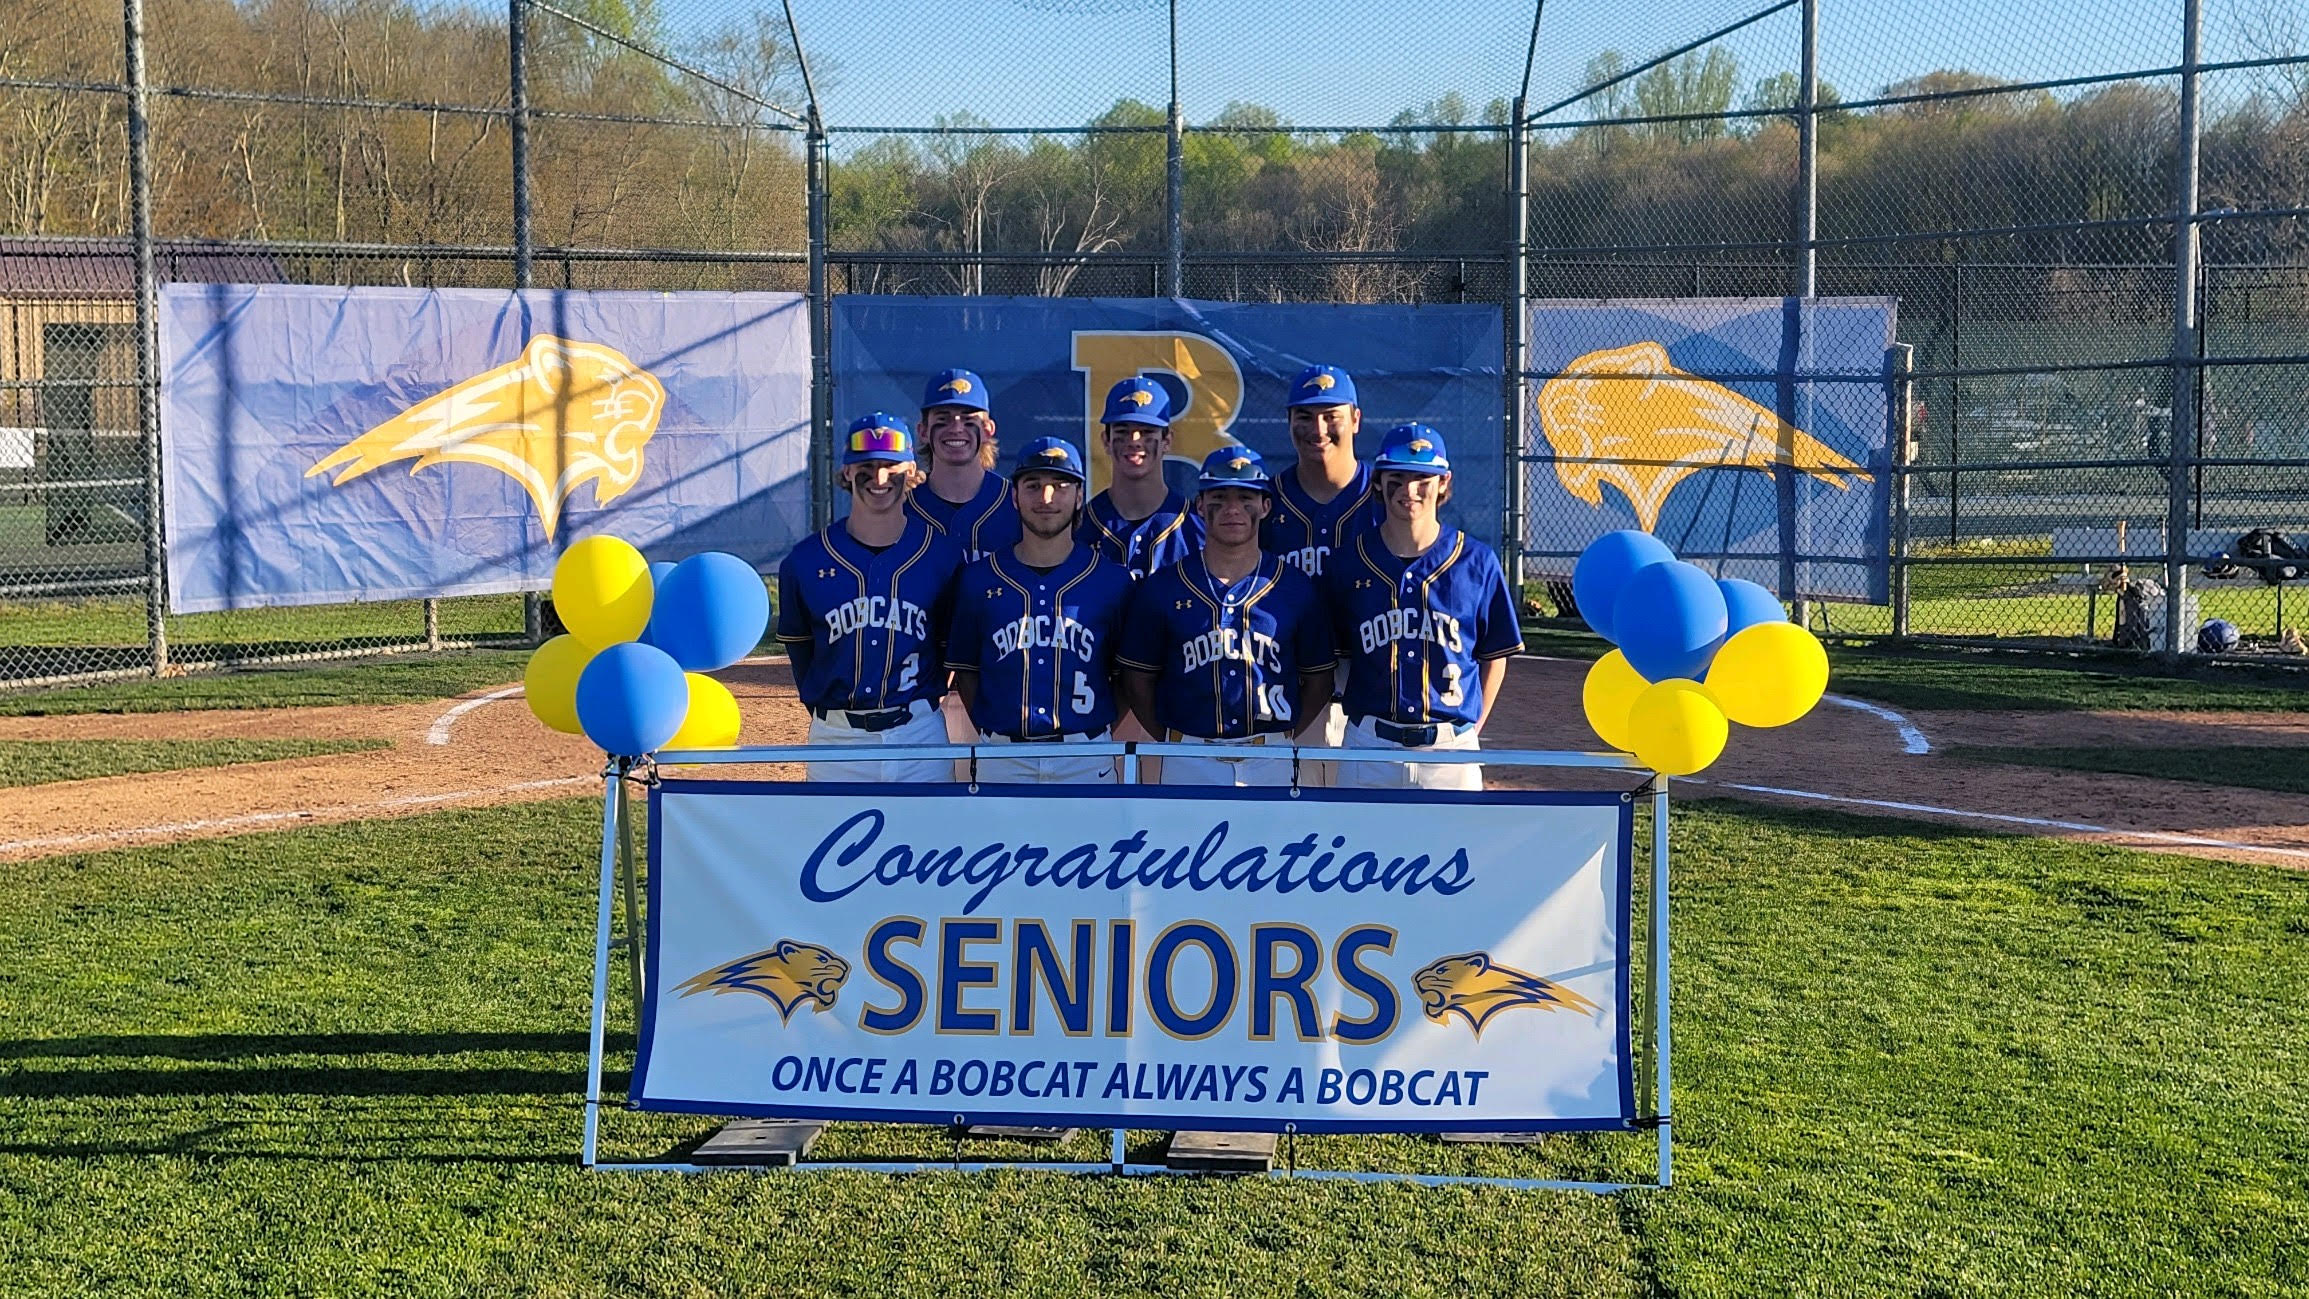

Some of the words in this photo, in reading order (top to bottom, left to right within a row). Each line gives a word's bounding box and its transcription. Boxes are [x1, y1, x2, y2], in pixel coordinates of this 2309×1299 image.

[825, 596, 927, 645] BOBCATS
[993, 615, 1095, 663] BOBCATS
[1360, 607, 1462, 654] BOBCATS
[897, 652, 920, 692] 2
[1183, 628, 1282, 674] BOBCATS
[1071, 670, 1095, 714] 5
[1256, 683, 1292, 721] 10
[1440, 663, 1463, 707] 3
[800, 808, 1475, 915] Congratulations
[857, 915, 1402, 1046] SENIORS
[771, 1055, 887, 1094] ONCE
[891, 1059, 918, 1095] A
[929, 1060, 1098, 1098] BOBCAT
[1102, 1062, 1268, 1103] ALWAYS
[1276, 1067, 1305, 1104] A
[1316, 1069, 1489, 1106] BOBCAT
